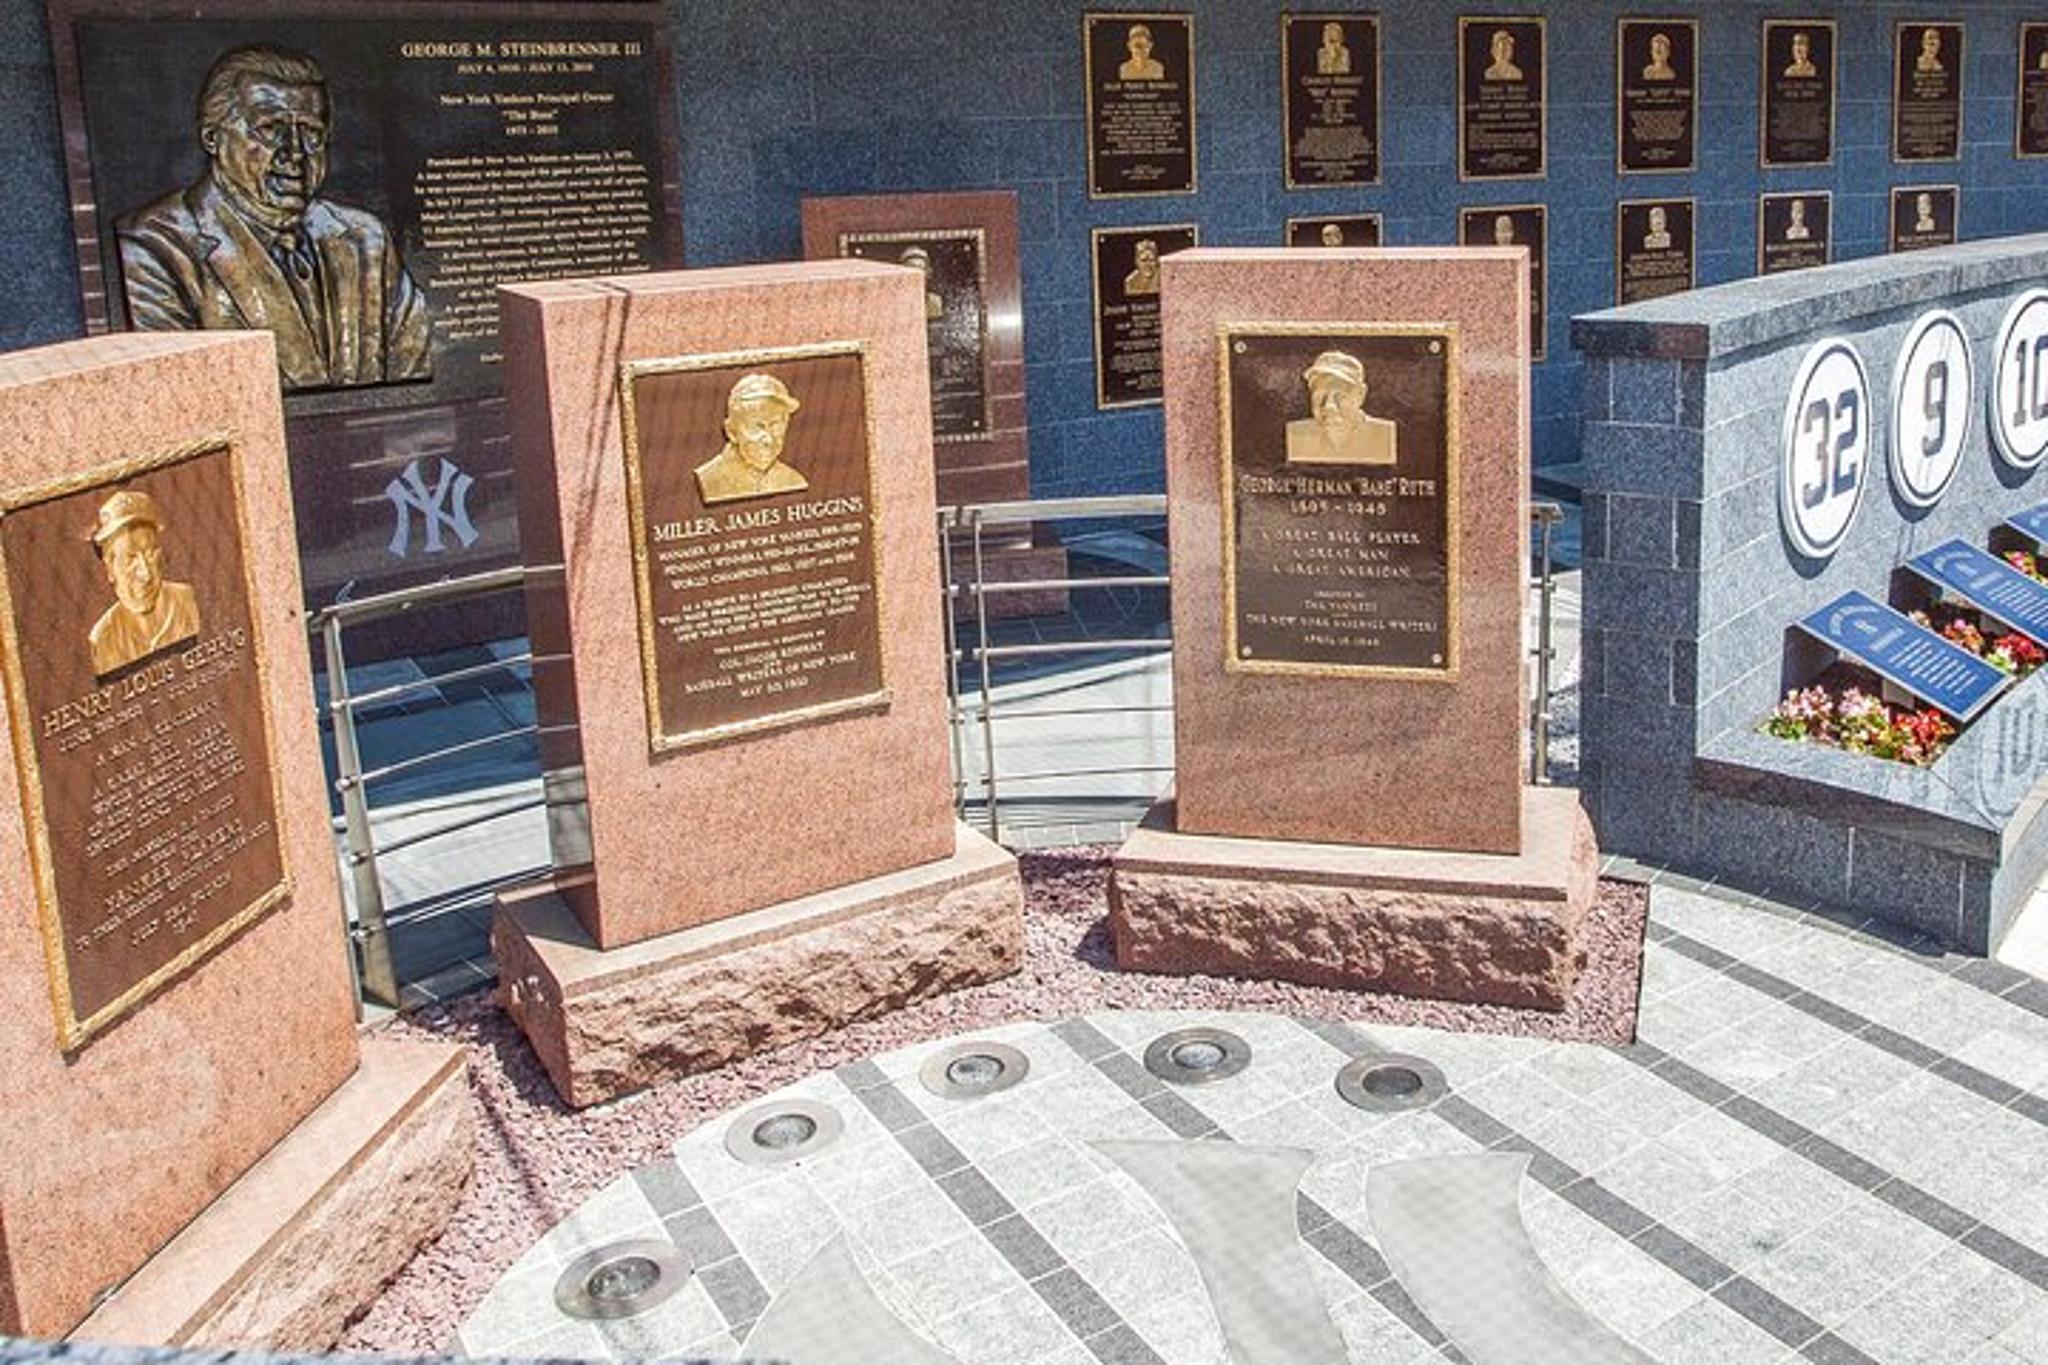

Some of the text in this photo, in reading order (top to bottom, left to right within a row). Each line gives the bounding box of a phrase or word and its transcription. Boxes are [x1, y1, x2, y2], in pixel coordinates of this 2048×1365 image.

[400, 42, 641, 58] GEORGE M. STEINBRENNER III
[440, 92, 615, 106] New York Yankees Principal Owner
[1922, 360, 1949, 458] 9
[1802, 387, 1859, 510] 32
[1296, 477, 1352, 496] HERMAN
[1398, 478, 1436, 496] RUTH
[386, 458, 479, 558] NY
[653, 496, 863, 542] MILLER JAMES HUGGINS
[659, 546, 706, 560] MANAGER
[708, 542, 720, 554] OF
[724, 540, 749, 552] NEW
[751, 534, 776, 546] YORK
[1369, 532, 1420, 544] PLAYER
[1360, 550, 1390, 561] MAN
[1340, 566, 1410, 578] AMERICAN
[671, 576, 710, 590] WORLD
[802, 656, 826, 669] NEW
[828, 650, 856, 664] YORK
[41, 684, 114, 738] HENRY
[122, 660, 174, 702] LOUIS
[182, 628, 245, 670] GEHRIG
